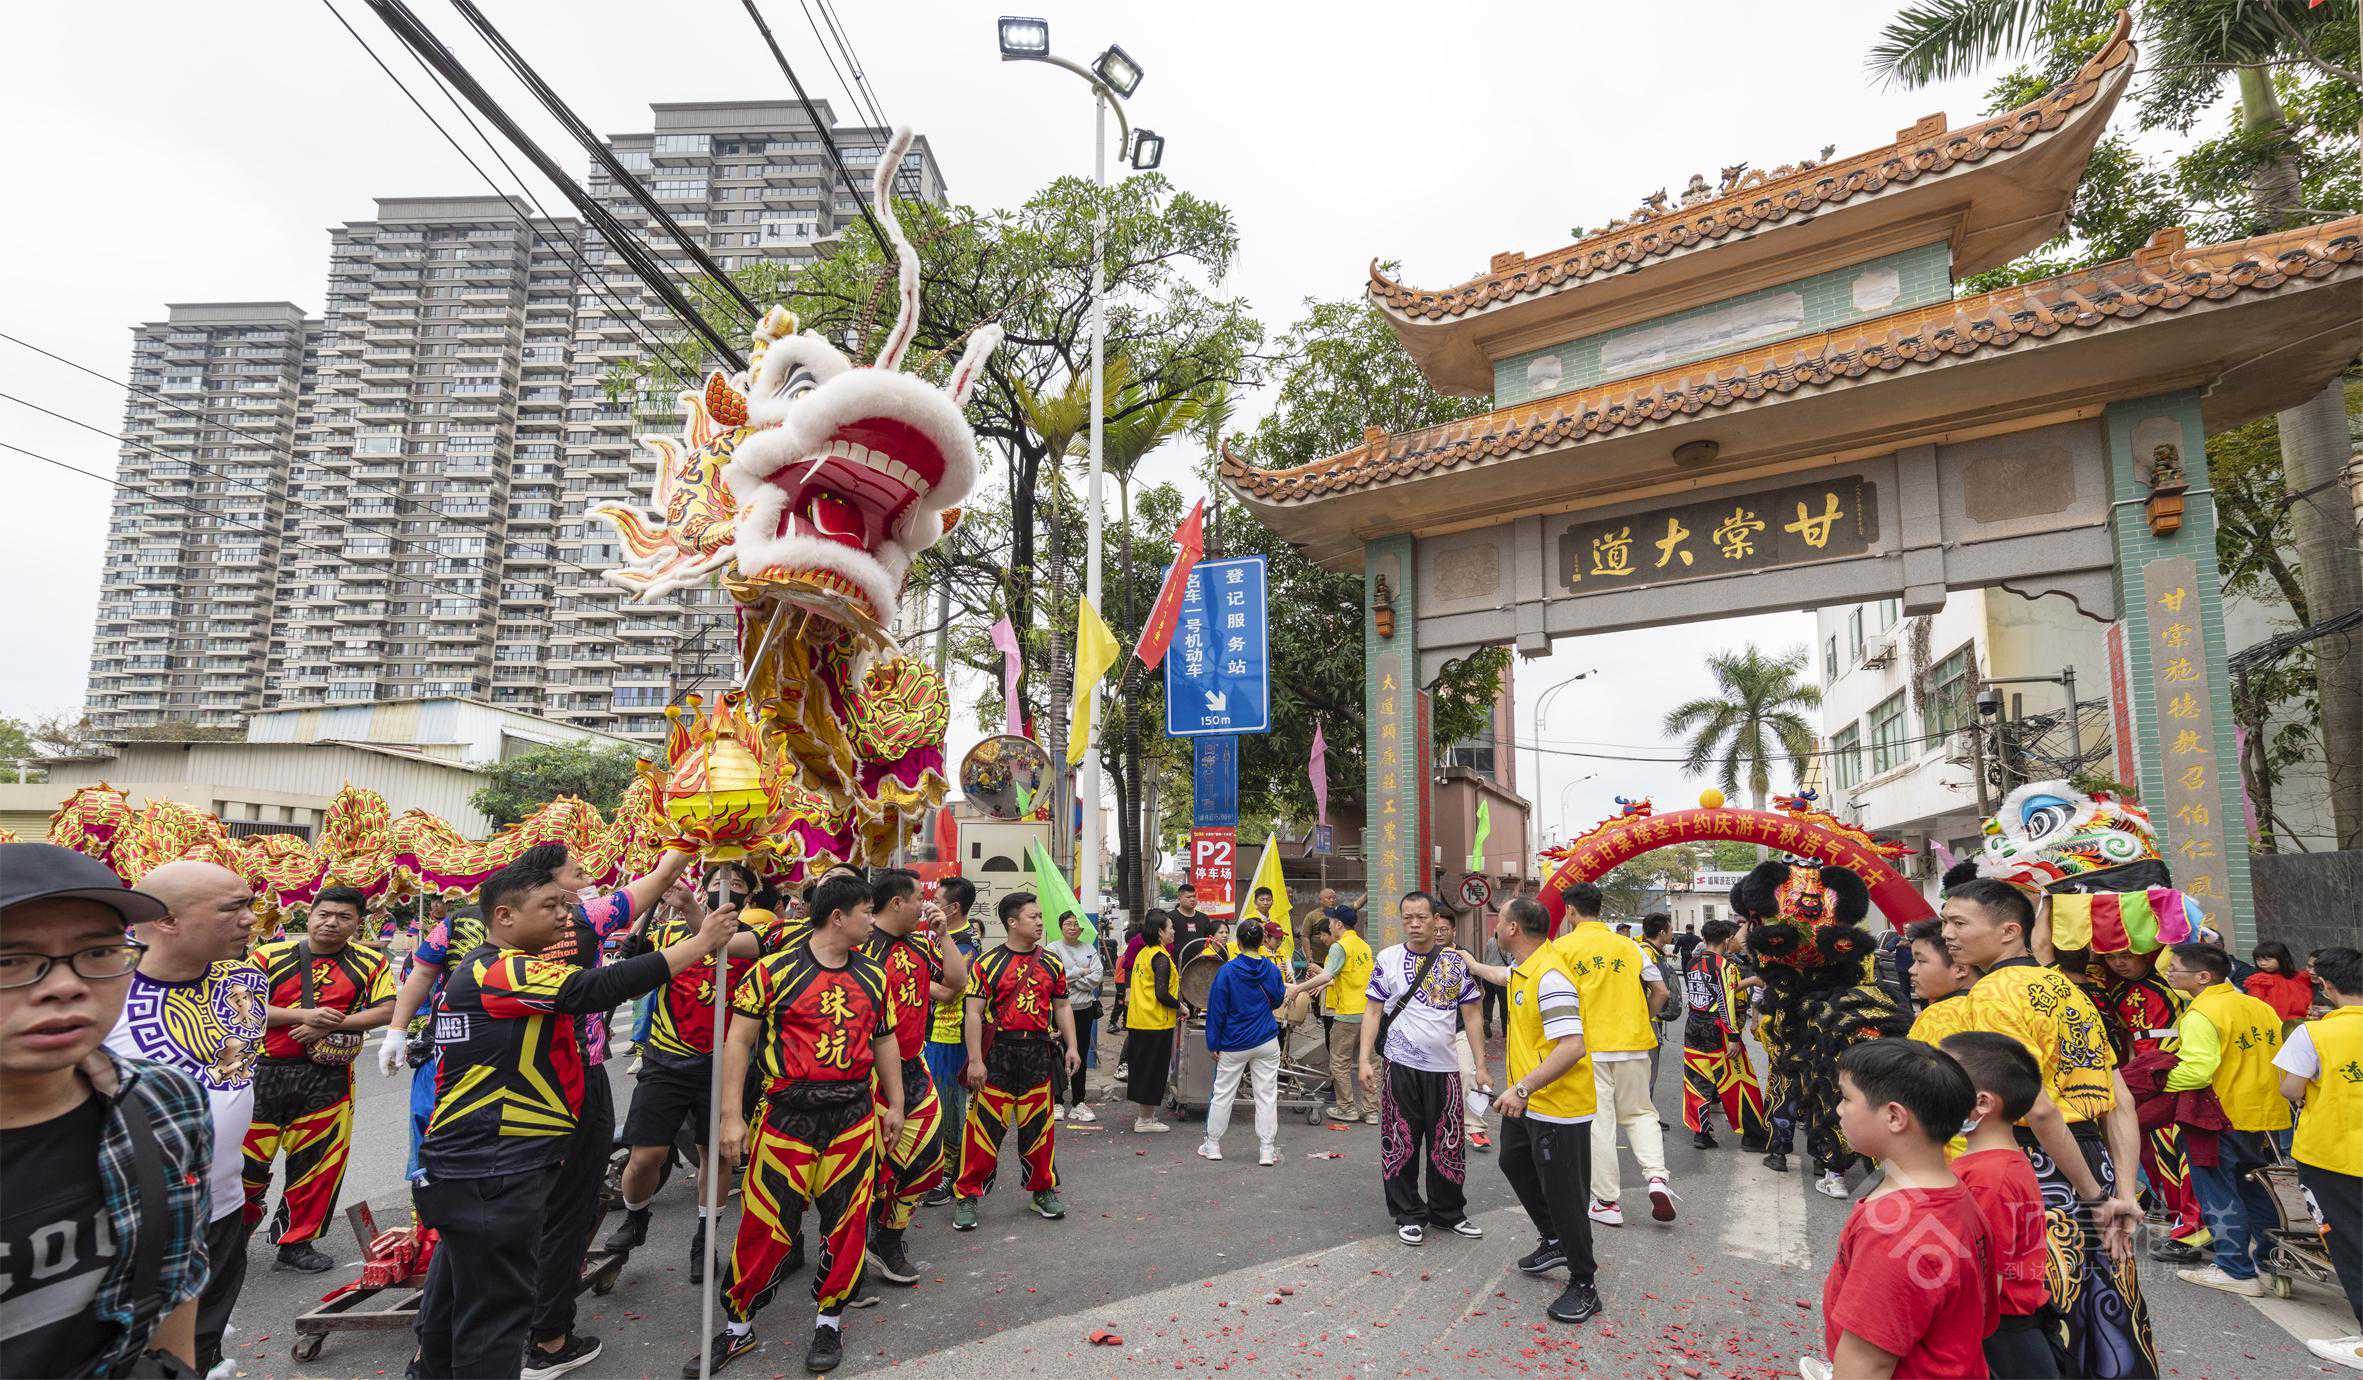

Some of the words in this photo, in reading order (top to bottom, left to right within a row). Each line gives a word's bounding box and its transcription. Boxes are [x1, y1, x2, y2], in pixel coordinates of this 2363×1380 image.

[1225, 568, 1247, 675] 登记服务站
[1200, 715, 1231, 726] 150m
[1195, 867, 1232, 880] 停车场
[1197, 840, 1232, 866] P2
[892, 946, 923, 1007] 珠坑
[814, 985, 855, 1070] 珠坑
